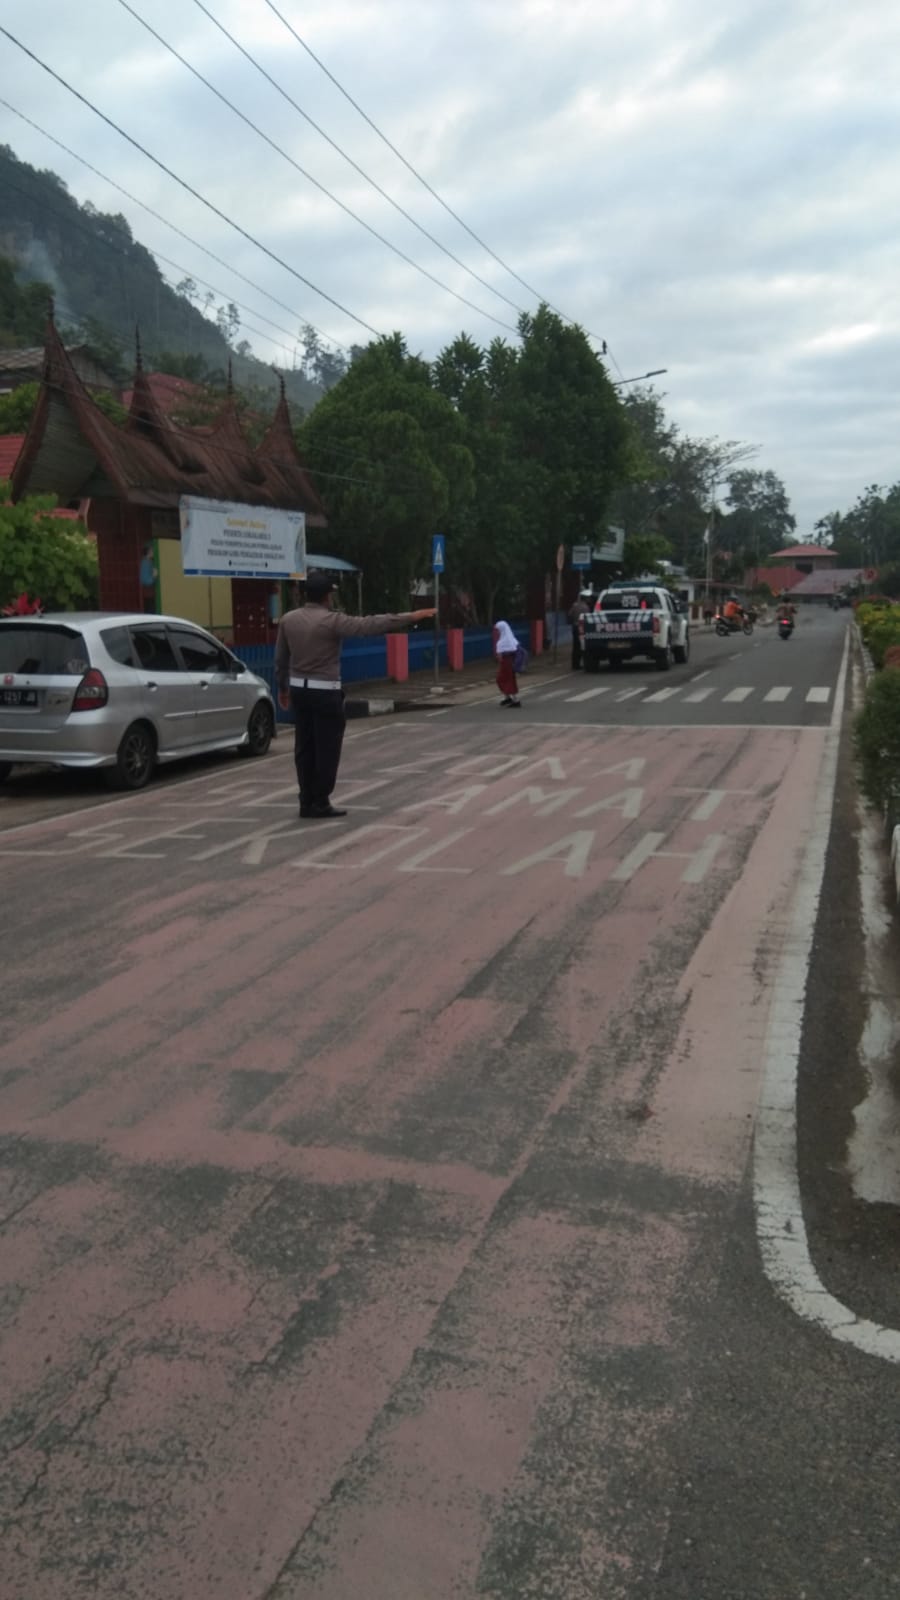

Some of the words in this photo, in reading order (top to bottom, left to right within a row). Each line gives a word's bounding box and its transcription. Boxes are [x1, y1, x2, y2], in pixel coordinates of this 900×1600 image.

[596, 623, 641, 632] POLISI
[376, 753, 646, 781] ZONA
[0, 816, 726, 884] SEKOLAH
